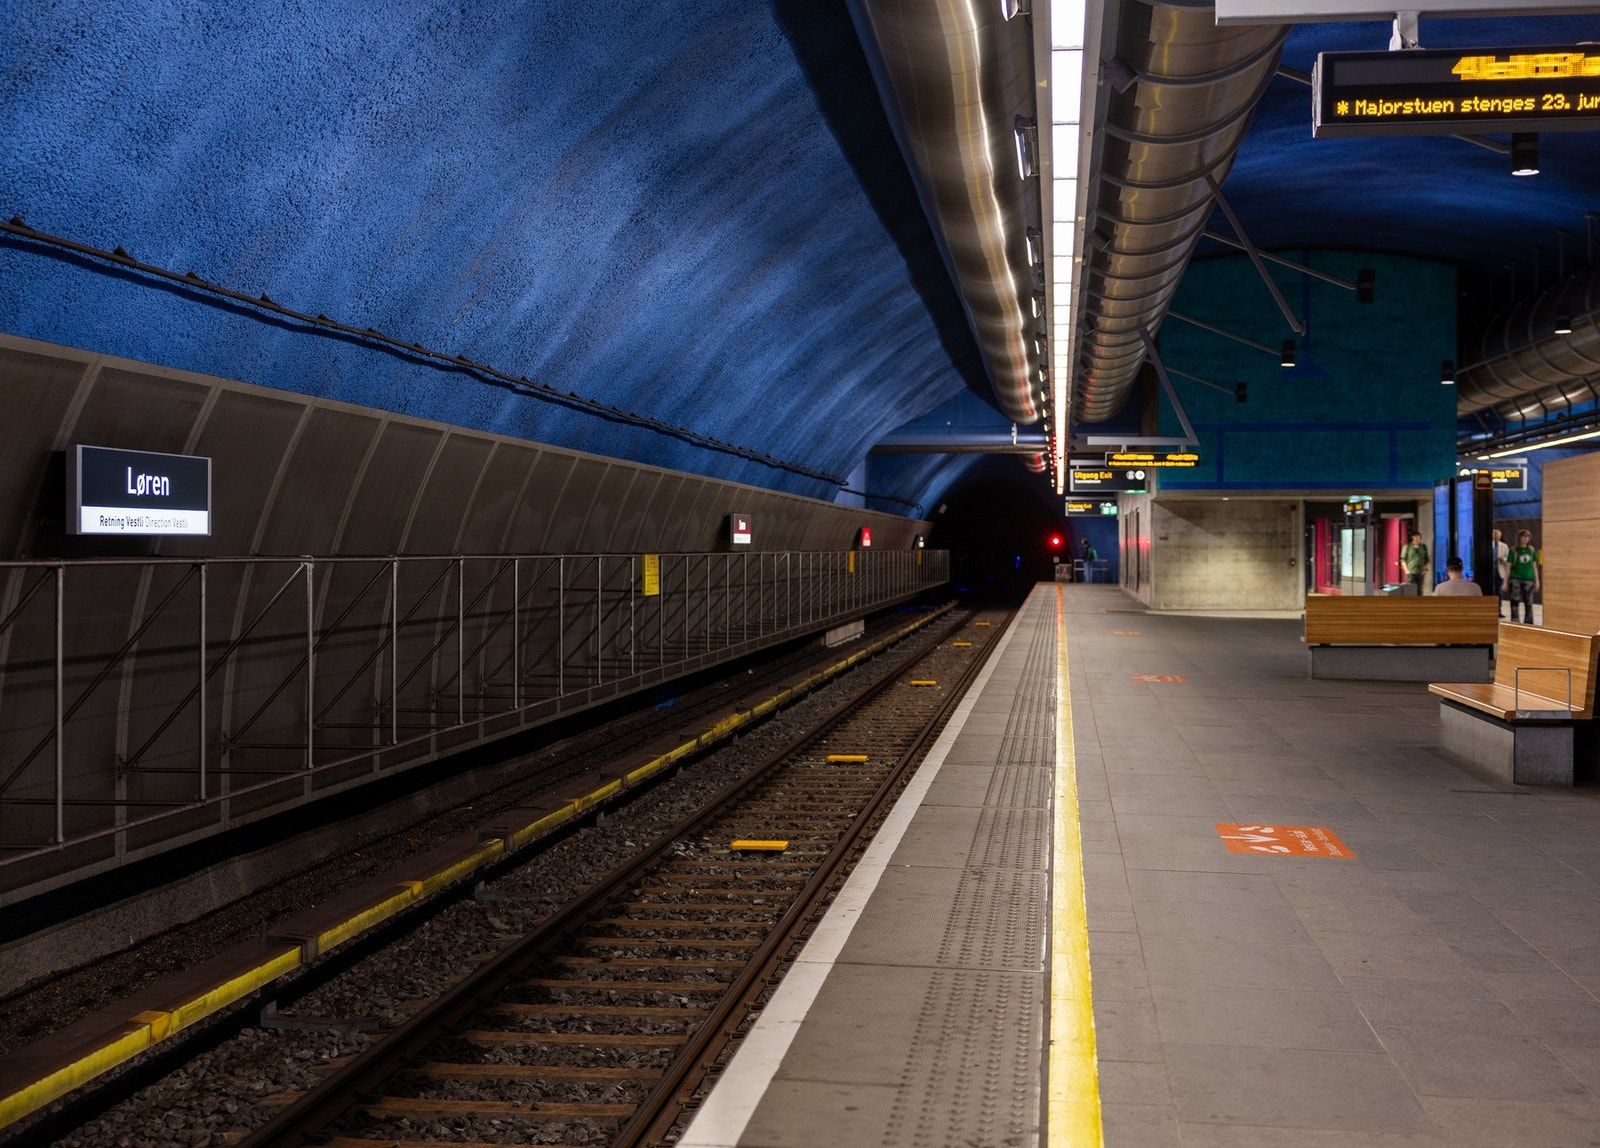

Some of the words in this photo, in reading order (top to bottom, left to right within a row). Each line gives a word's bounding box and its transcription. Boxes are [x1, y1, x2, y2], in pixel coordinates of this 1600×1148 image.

[1355, 98, 1455, 117] Majorstuen
[1461, 96, 1536, 113] stenges
[1542, 93, 1571, 111] 23.
[127, 466, 170, 496] Løren
[1100, 471, 1113, 479] Exit
[99, 515, 125, 530] Retning
[126, 515, 144, 527] Vestli
[145, 516, 171, 528] Direction
